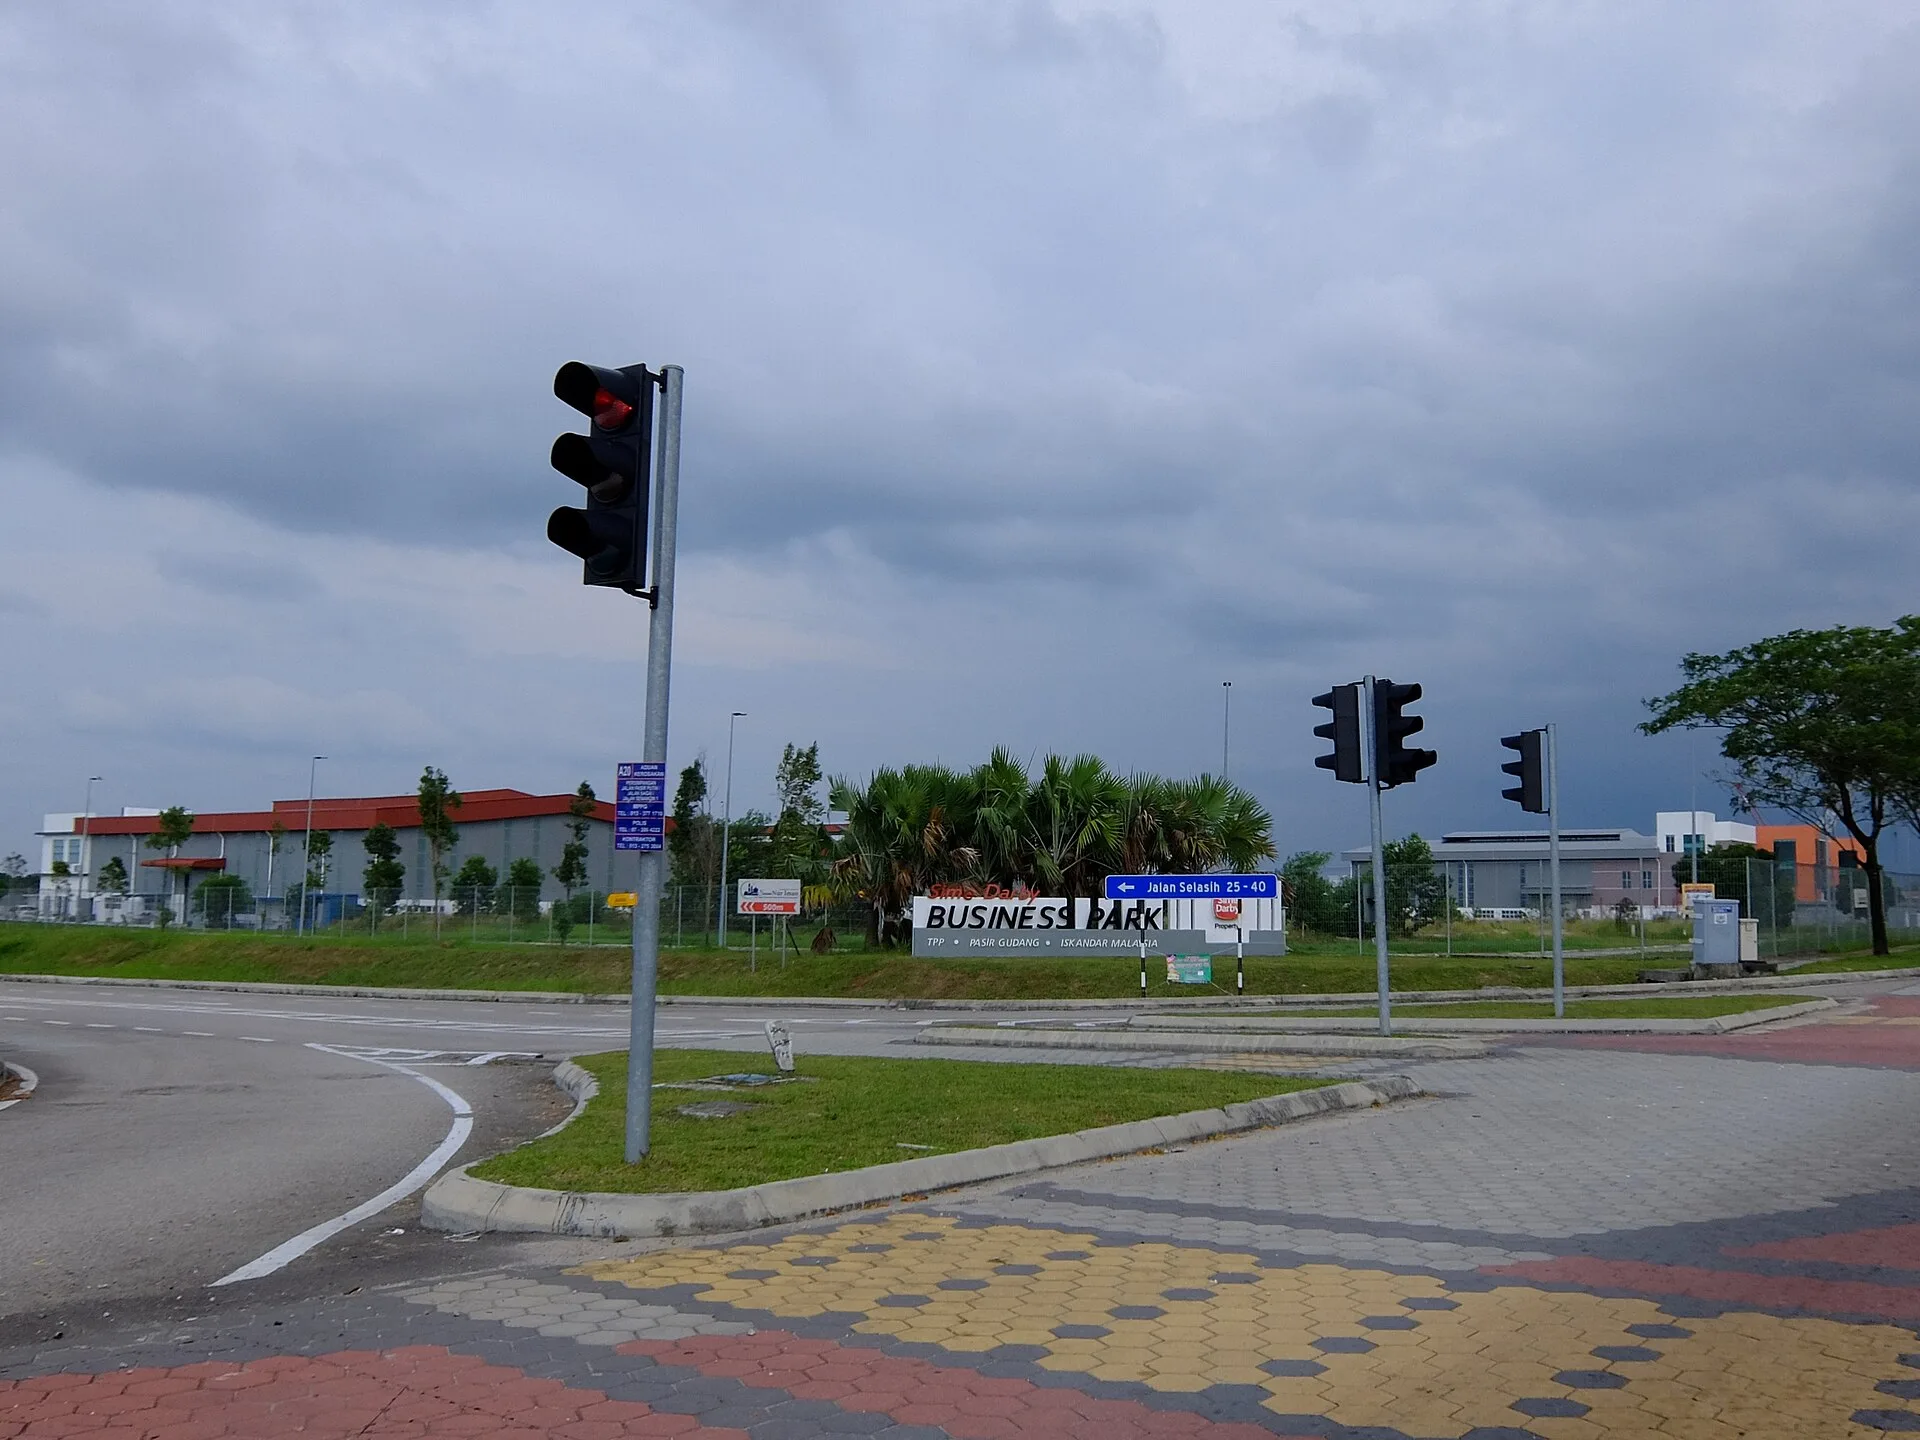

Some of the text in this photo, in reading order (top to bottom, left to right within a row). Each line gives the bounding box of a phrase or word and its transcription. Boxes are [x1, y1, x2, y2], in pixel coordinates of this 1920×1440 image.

[618, 765, 631, 777] A20
[1147, 882, 1176, 893] Jalan
[1180, 881, 1220, 893] Selasih
[928, 882, 1040, 905] Sime Darby
[1216, 903, 1239, 915] Darby
[926, 905, 1162, 930] BUSINESS PARK
[927, 937, 945, 947] TPP
[969, 937, 1040, 948] PASIR GUDANG
[1060, 938, 1108, 948] ISKANDAR
